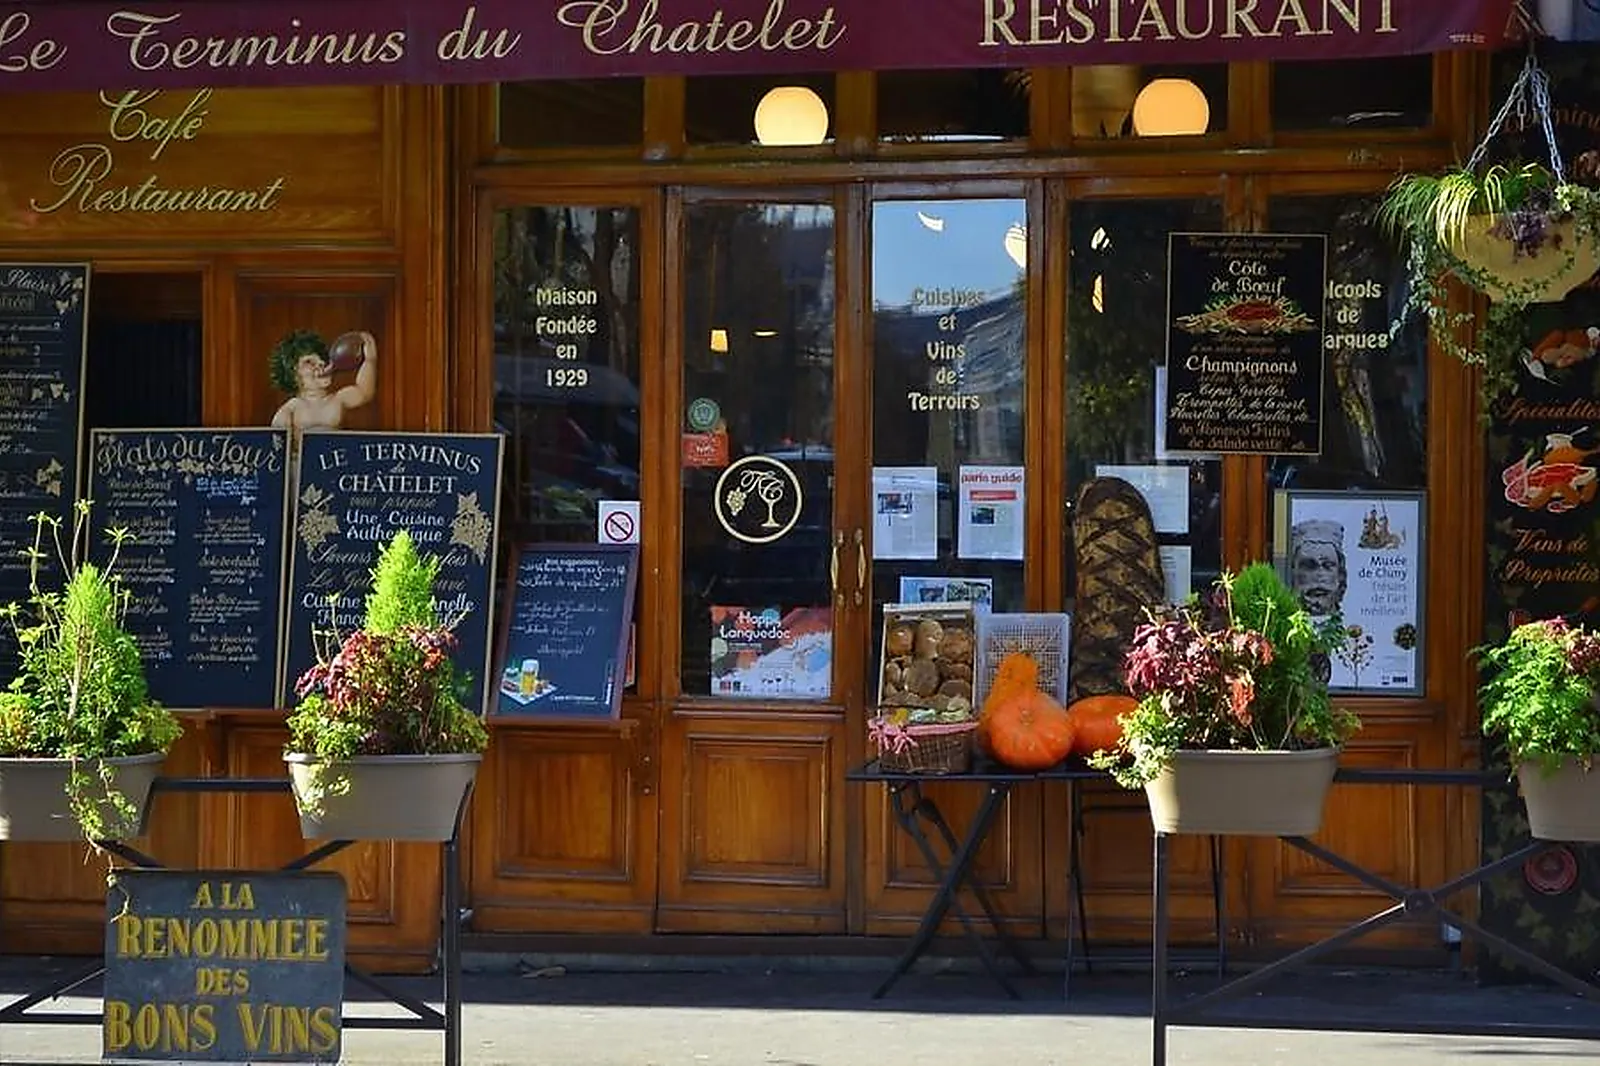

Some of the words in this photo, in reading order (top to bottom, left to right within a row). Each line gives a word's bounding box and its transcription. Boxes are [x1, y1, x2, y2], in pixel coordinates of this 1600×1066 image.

[978, 0, 1399, 46] RESTAURANT
[0, 12, 68, 72] Le
[107, 11, 406, 71] Terminus
[437, 7, 521, 60] du
[556, 0, 847, 55] Chatelet
[99, 88, 213, 160] Café
[30, 143, 285, 213] Restaurant
[536, 287, 598, 306] Maison
[912, 287, 985, 305] Cuisines
[1328, 280, 1382, 299] lcools
[938, 313, 957, 331] et
[1337, 304, 1360, 324] de
[535, 315, 598, 335] Fondée
[926, 340, 966, 360] Vins
[1324, 332, 1389, 349] arques
[556, 344, 577, 360] en
[936, 366, 957, 384] de
[1186, 355, 1298, 377] Champignons
[547, 369, 588, 386] 1929
[907, 392, 981, 411] Terroirs
[209, 434, 281, 473] Jour
[319, 449, 348, 471] LE
[360, 442, 482, 475] TERMINUS
[338, 470, 458, 494] CHÂTELET
[346, 510, 379, 526] Une
[388, 510, 445, 527] Cuisine
[1369, 556, 1407, 567] Musée
[1359, 568, 1373, 578] de
[1375, 568, 1407, 581] Cluny
[720, 624, 791, 641] Languedoc
[189, 882, 214, 909] A
[217, 882, 256, 910] LA
[116, 915, 329, 962] RENOMMEE
[195, 966, 250, 996] DES
[104, 1000, 219, 1053] BONS
[235, 1002, 340, 1054] VINS
